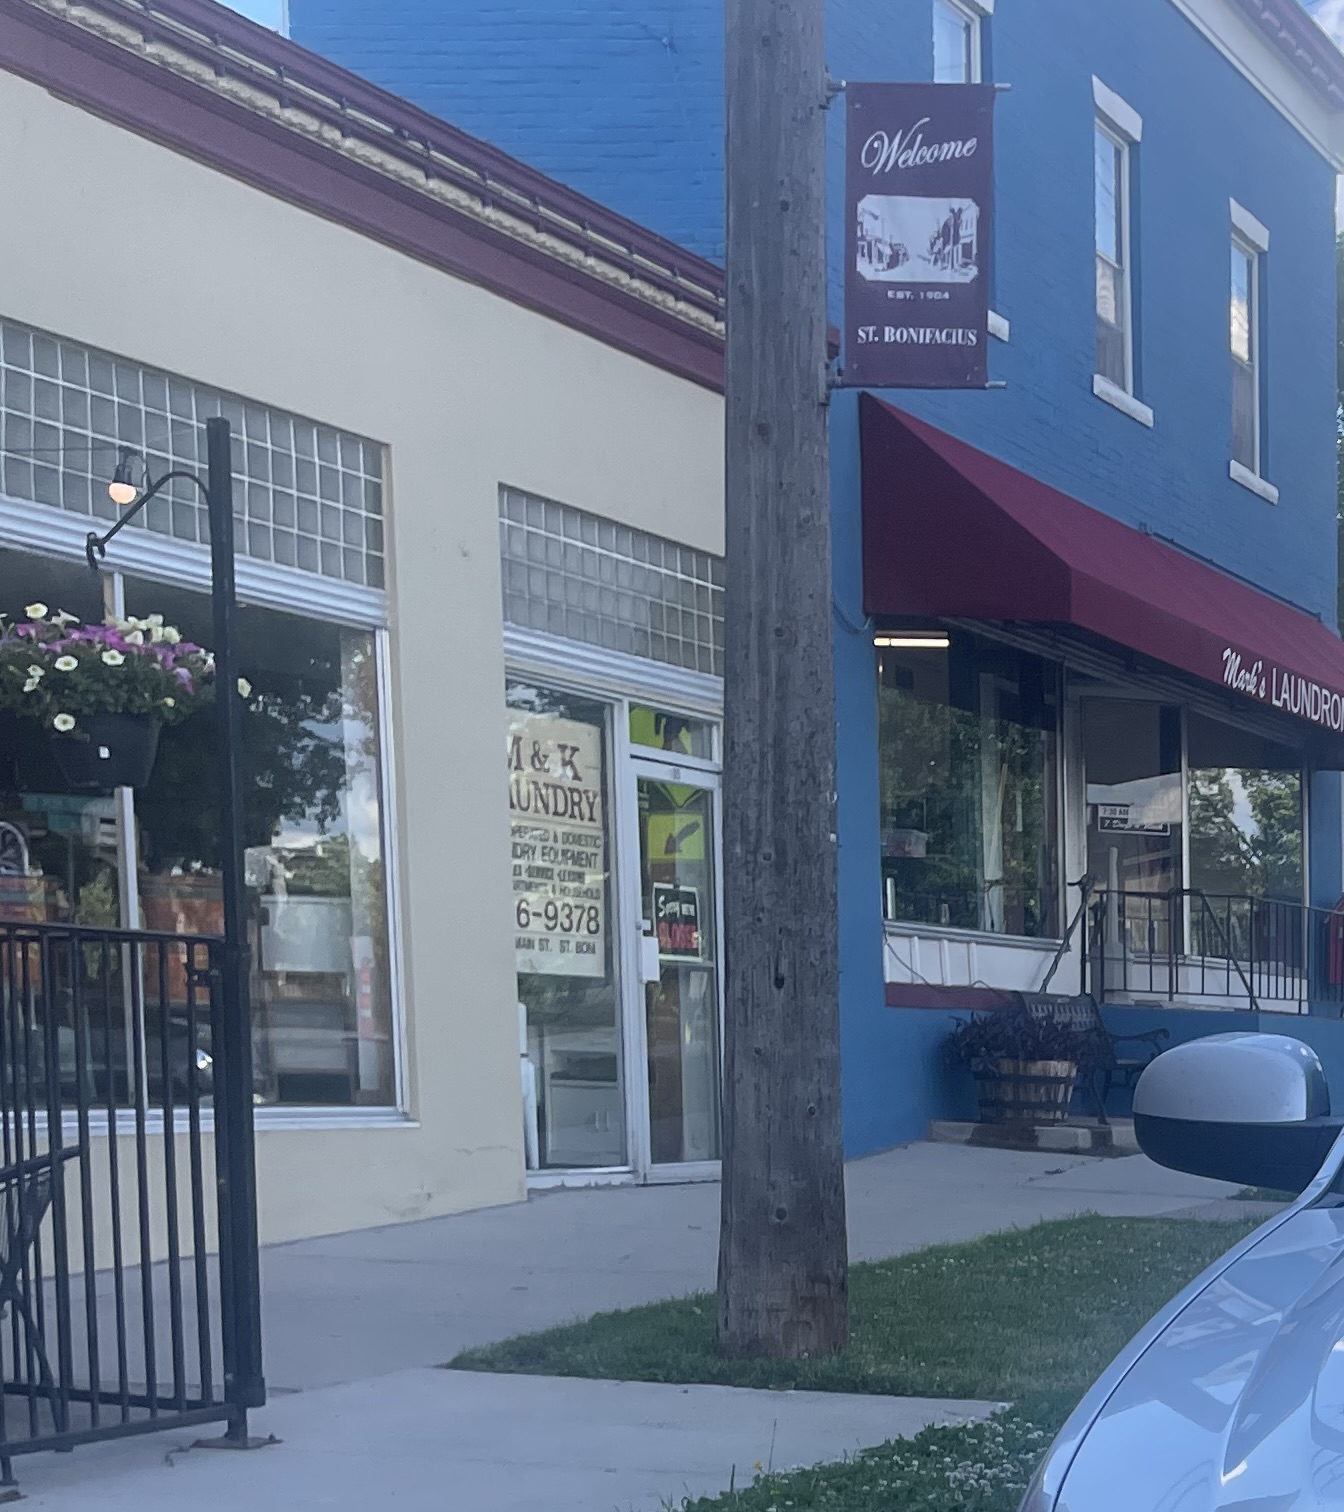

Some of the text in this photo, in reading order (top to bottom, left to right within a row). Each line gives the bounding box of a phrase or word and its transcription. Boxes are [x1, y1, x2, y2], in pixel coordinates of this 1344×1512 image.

[861, 117, 977, 176] Welcome
[857, 326, 978, 347] ST. BONIFACIUS
[1222, 647, 1266, 699] Mark's
[531, 740, 550, 773] &
[557, 744, 582, 782] K
[541, 846, 598, 870] EQUIPMENT
[517, 899, 600, 935] 6-9378
